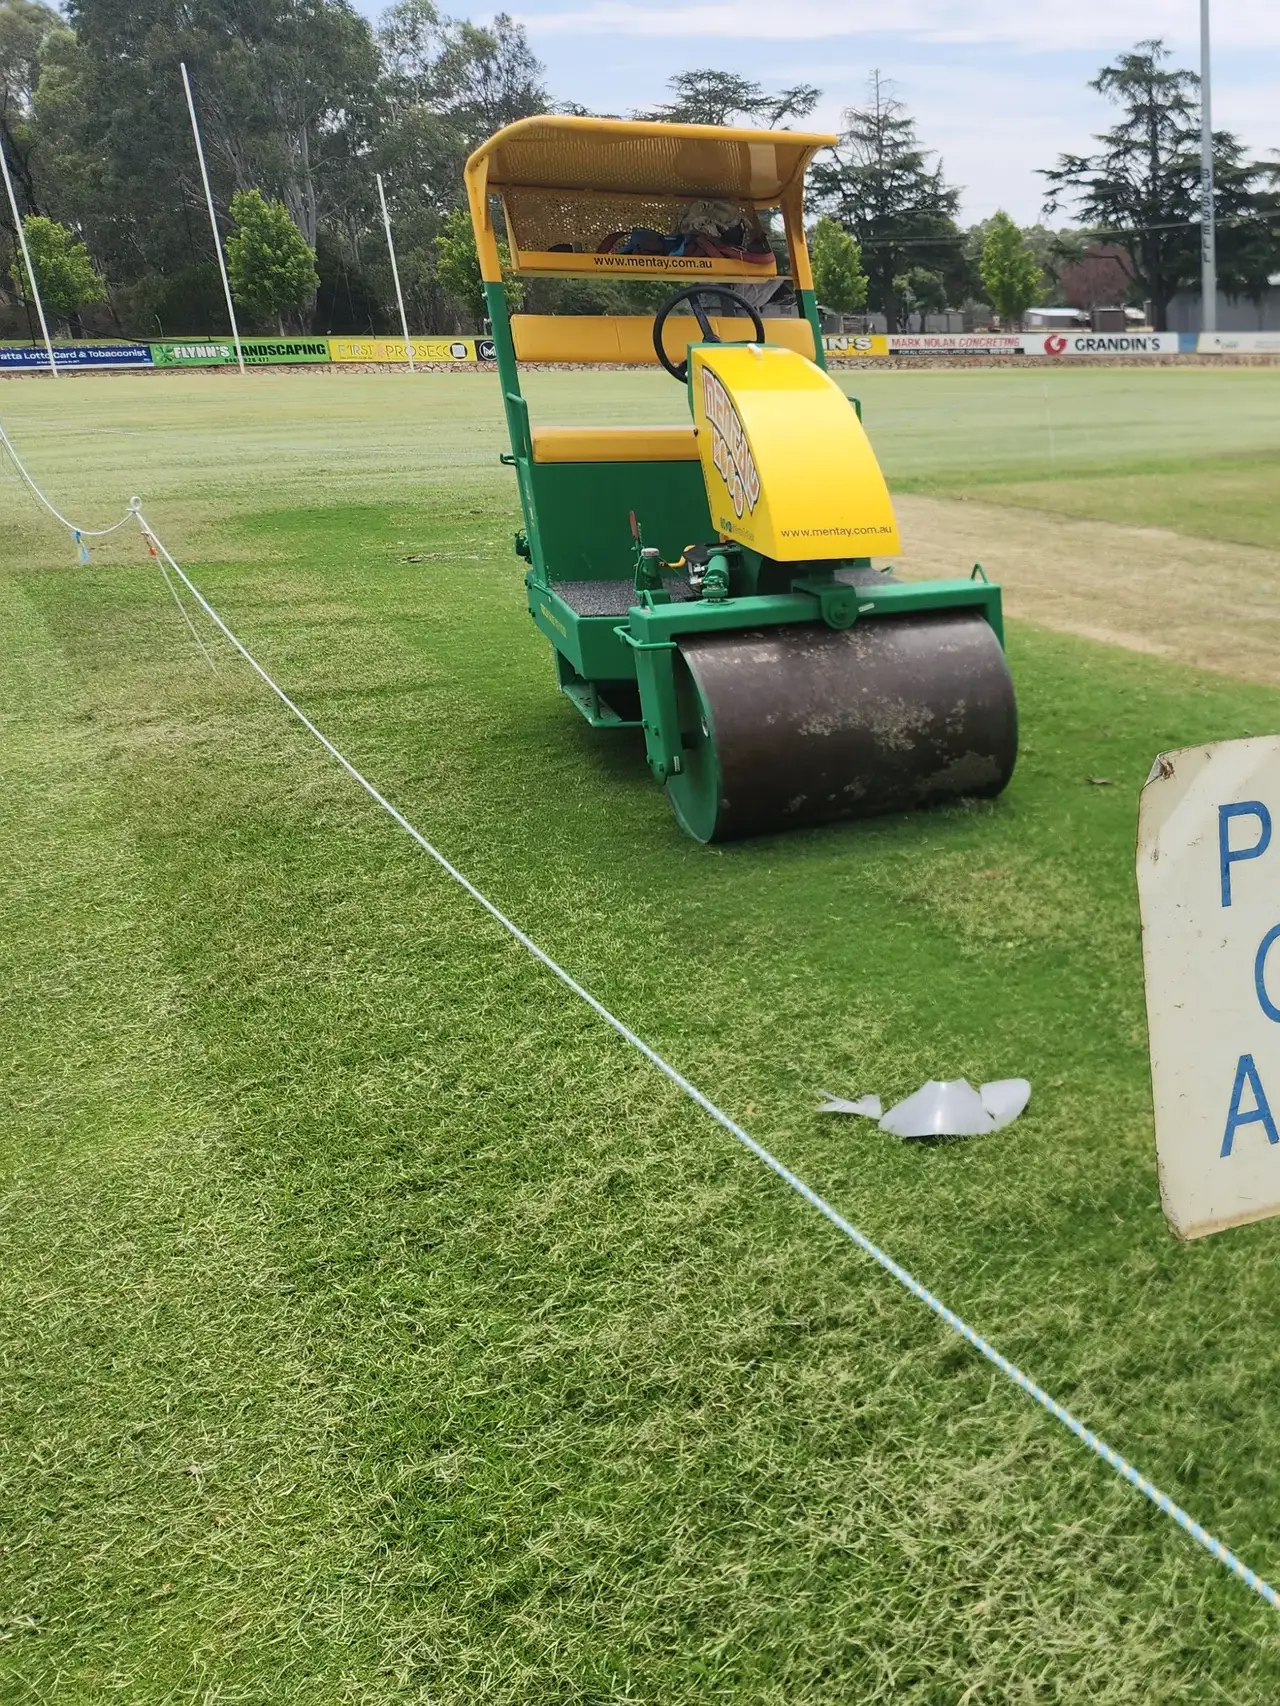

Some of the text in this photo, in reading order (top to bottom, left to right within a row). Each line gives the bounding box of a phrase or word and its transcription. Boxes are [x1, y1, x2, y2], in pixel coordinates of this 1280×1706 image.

[593, 256, 713, 270] www.mentay.com.au
[891, 337, 1020, 348] MARK NOLAN CONCRETING
[1075, 337, 1160, 351] GRANDIN'S
[53, 349, 76, 359] Card
[78, 349, 86, 358] &
[89, 348, 147, 358] Tobacconist
[173, 343, 325, 358] FLYNN'S LANDSCAPING
[781, 525, 892, 537] www.mentay.com.au
